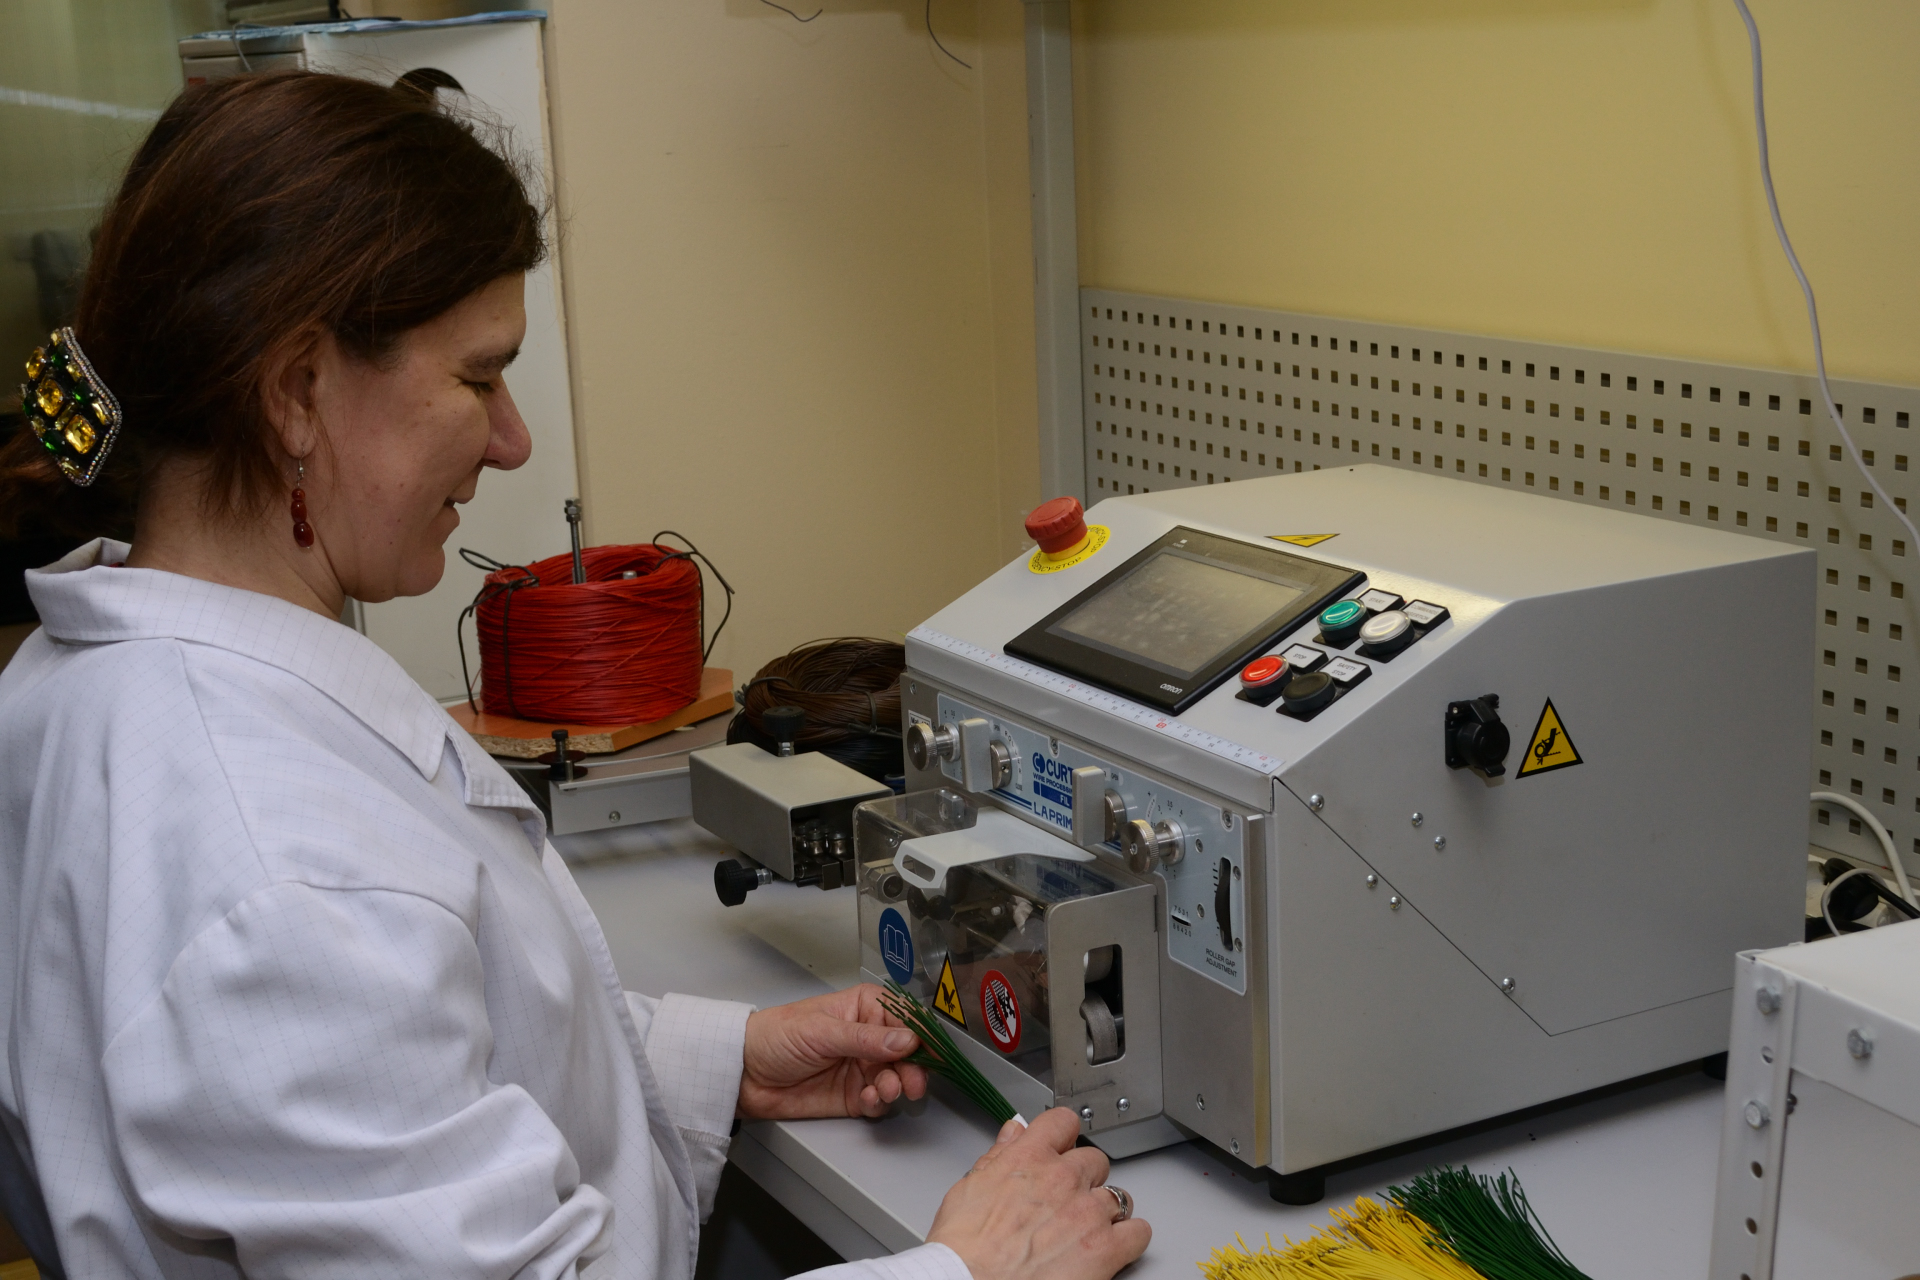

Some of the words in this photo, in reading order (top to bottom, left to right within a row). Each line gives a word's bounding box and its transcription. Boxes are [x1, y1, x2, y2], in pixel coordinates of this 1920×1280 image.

[1369, 597, 1385, 605] START
[1337, 662, 1357, 671] SAFETY
[1033, 771, 1046, 783] WIRE
[1046, 758, 1073, 786] CURT
[1206, 948, 1225, 963] ROLLER
[1225, 956, 1236, 968] GAP
[1206, 957, 1238, 978] ADJUSTMENT
